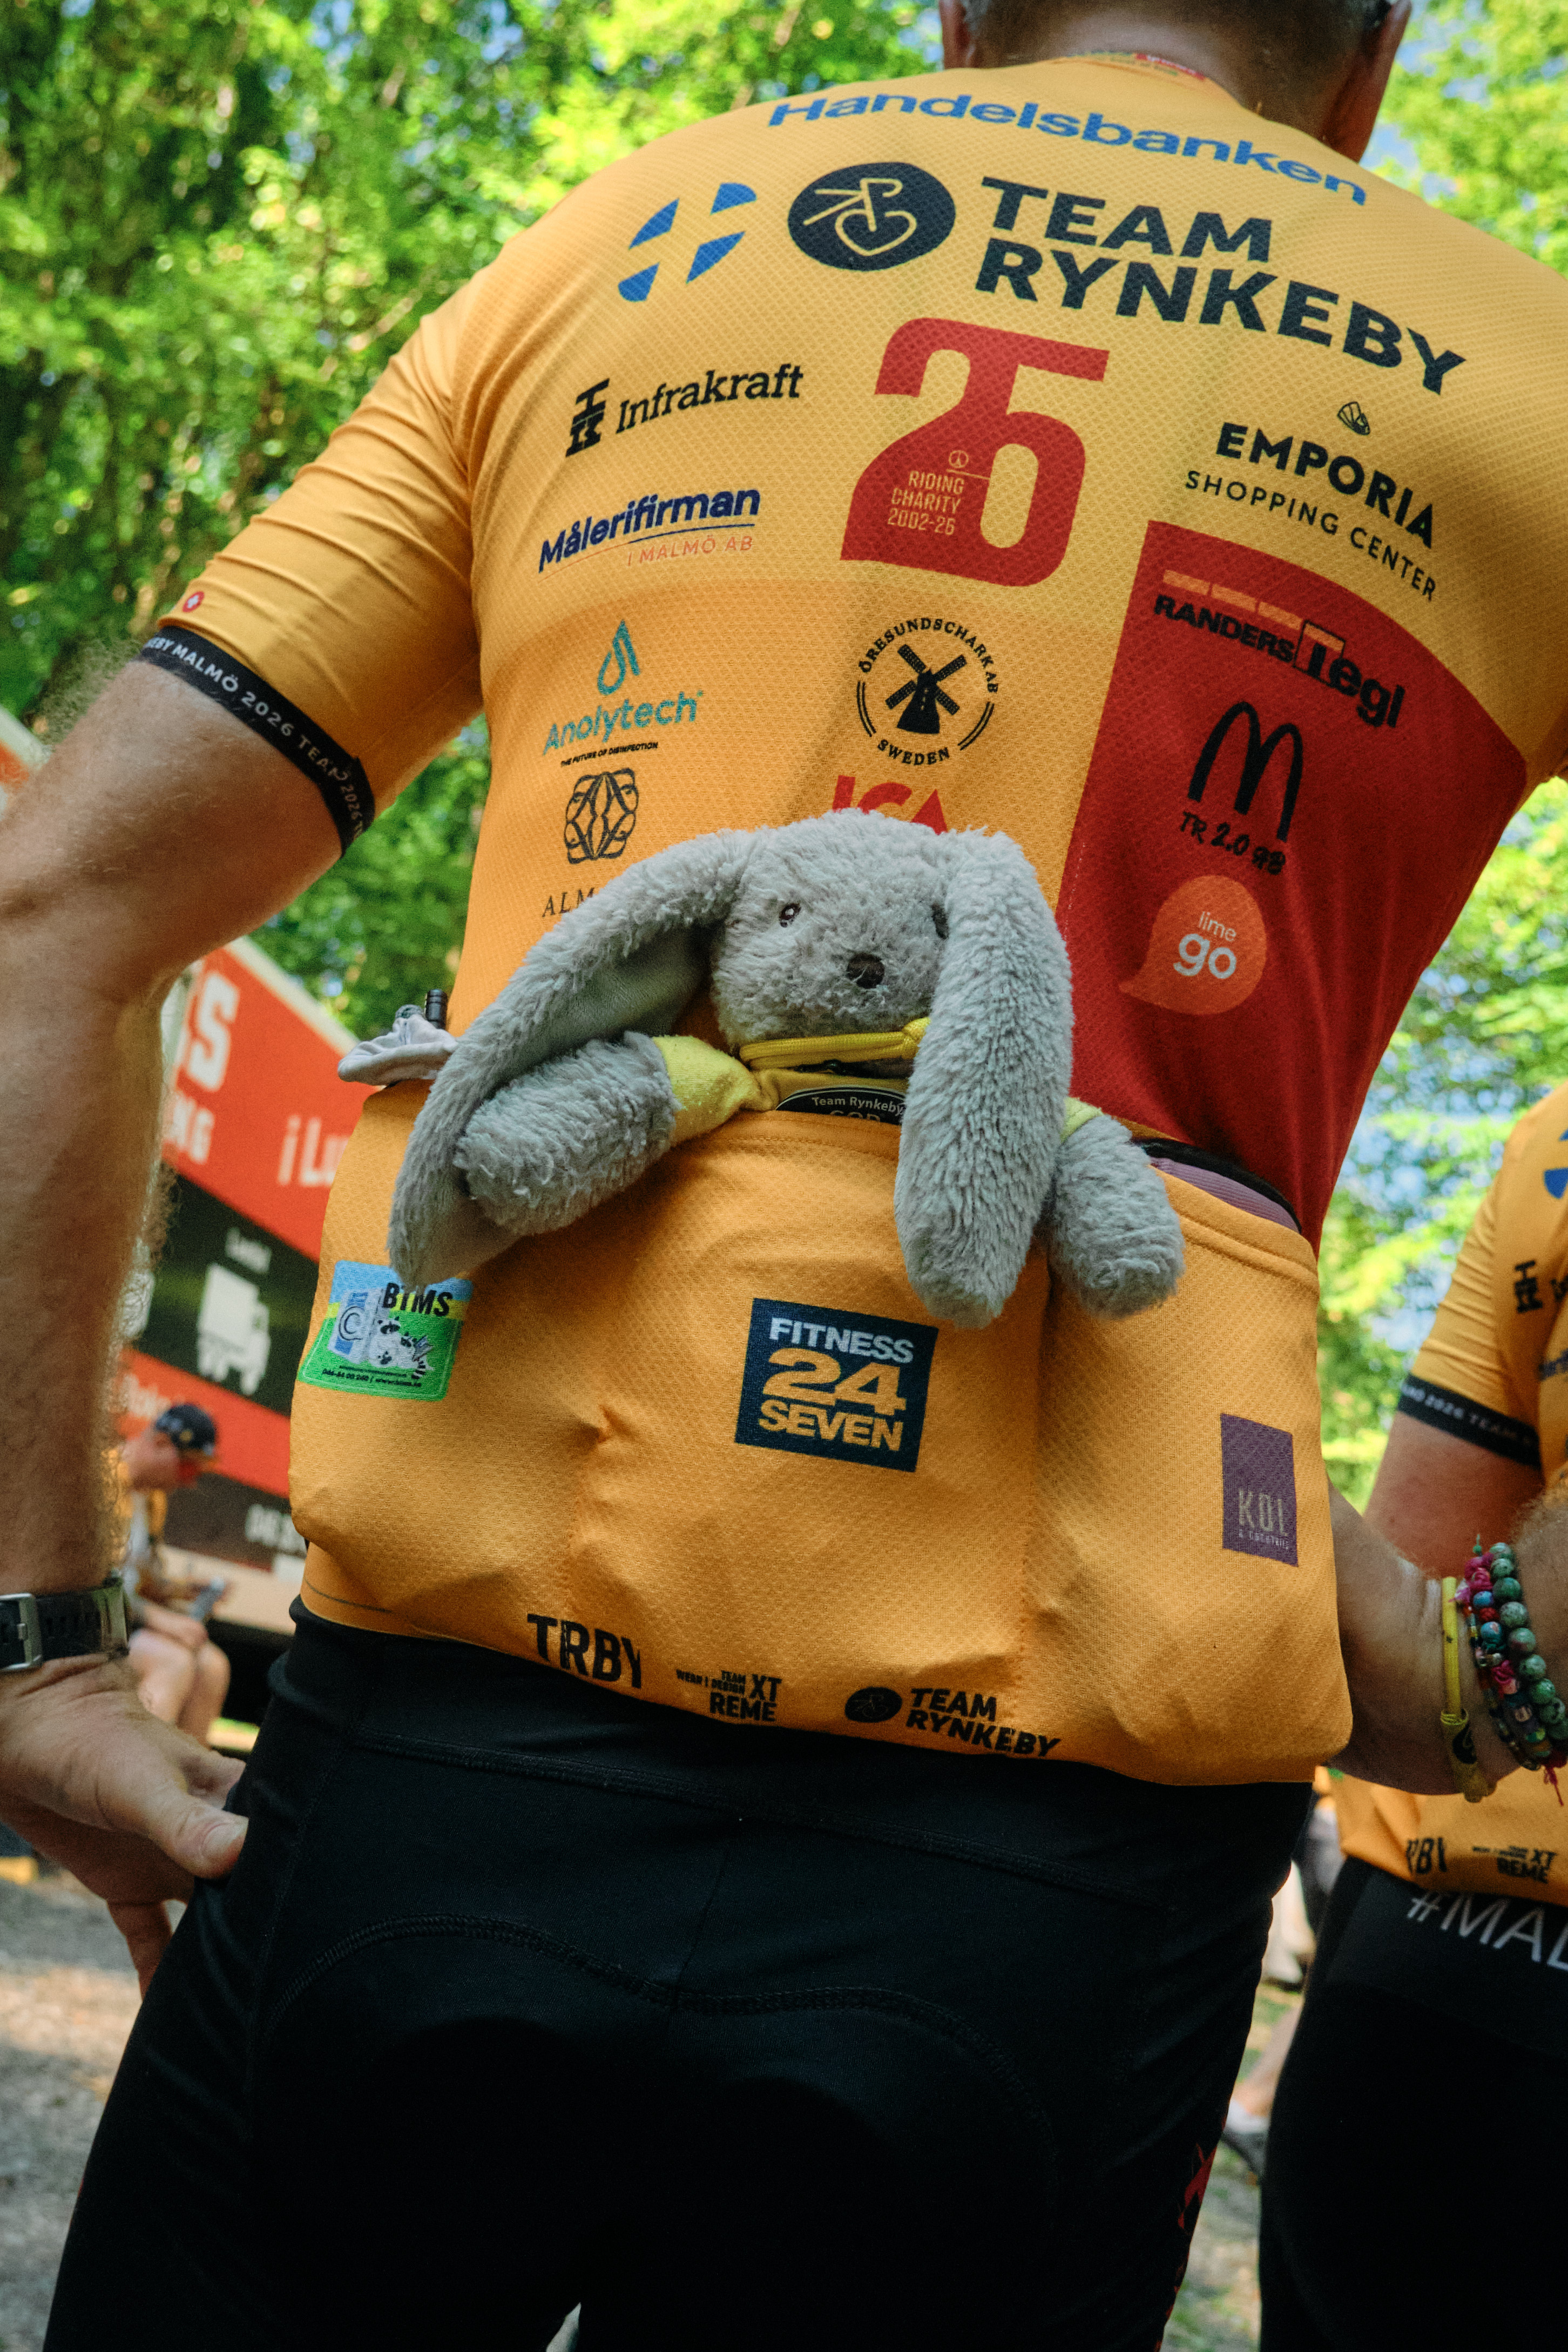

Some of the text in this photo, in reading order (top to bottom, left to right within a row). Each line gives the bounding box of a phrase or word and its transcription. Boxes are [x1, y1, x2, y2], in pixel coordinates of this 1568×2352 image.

[767, 93, 1366, 206] Handelsbanken
[982, 176, 1273, 262] TEAM
[975, 237, 1466, 395] RYNKEBY
[615, 363, 804, 434] Infrakraft
[891, 488, 962, 515] CHARITY
[908, 470, 965, 495] RIDING
[1215, 422, 1434, 549] EMPORIA
[538, 489, 761, 574] Målerifirman
[887, 508, 956, 536] 2002-26
[1185, 470, 1437, 602] SHOPPING CENTER
[639, 534, 717, 564] MALMÖ
[724, 535, 753, 552] AB
[1153, 594, 1296, 664] RANDERS
[171, 644, 239, 693] MALMÖ
[241, 691, 294, 737] 2026
[985, 671, 999, 694] AB
[542, 691, 697, 757] Anolytech
[876, 739, 950, 766] SWEDEN
[1180, 811, 1207, 844] TR
[1210, 822, 1251, 856] 2.0
[1197, 911, 1237, 942] lime
[1173, 932, 1237, 980] go
[812, 1096, 846, 1107] Team
[849, 1096, 905, 1117] Rynkeby
[769, 1317, 915, 1363] FITNESS
[762, 1347, 907, 1416] 24
[758, 1399, 904, 1452] SEVEN
[527, 1613, 643, 1689] TRBY
[709, 1691, 778, 1722] REME
[749, 1674, 782, 1702] XT
[910, 1687, 997, 1722] TEAM
[905, 1709, 1061, 1758] RYNKEBY
